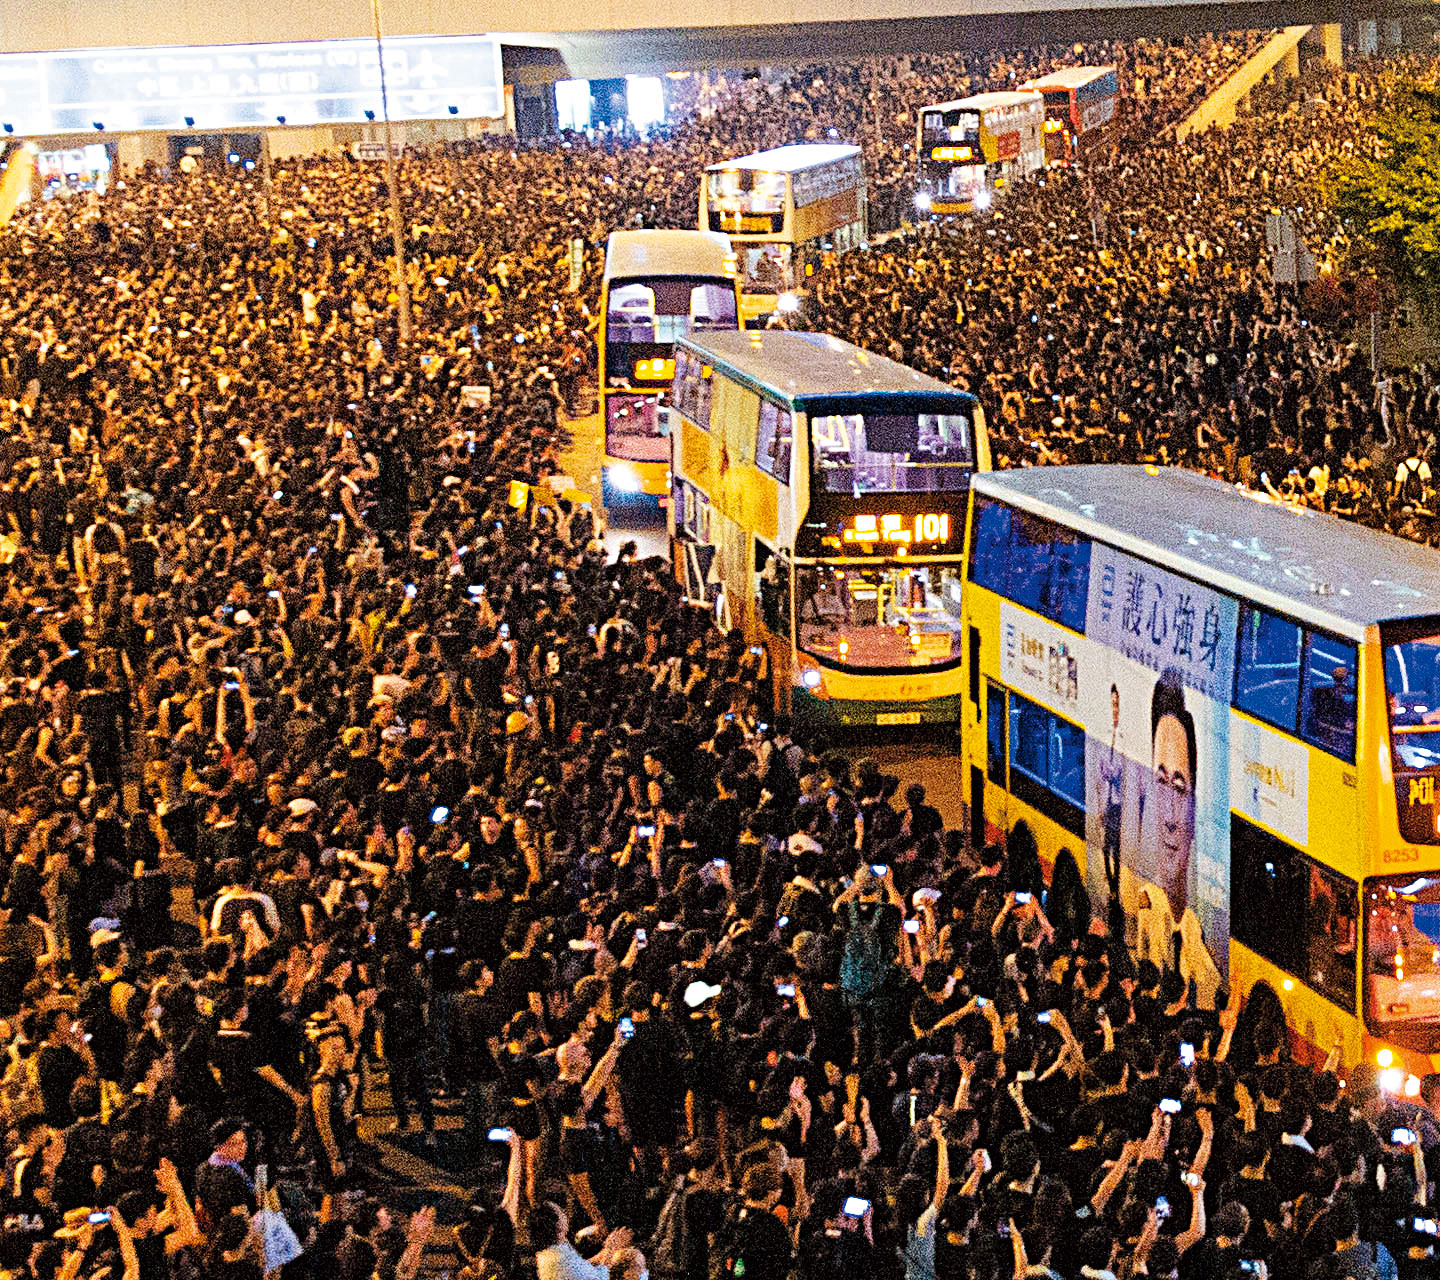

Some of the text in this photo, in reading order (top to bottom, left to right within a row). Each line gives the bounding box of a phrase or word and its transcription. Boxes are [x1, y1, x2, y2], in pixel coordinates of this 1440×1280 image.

[914, 512, 949, 541] 101
[1122, 571, 1221, 671] 護心強身
